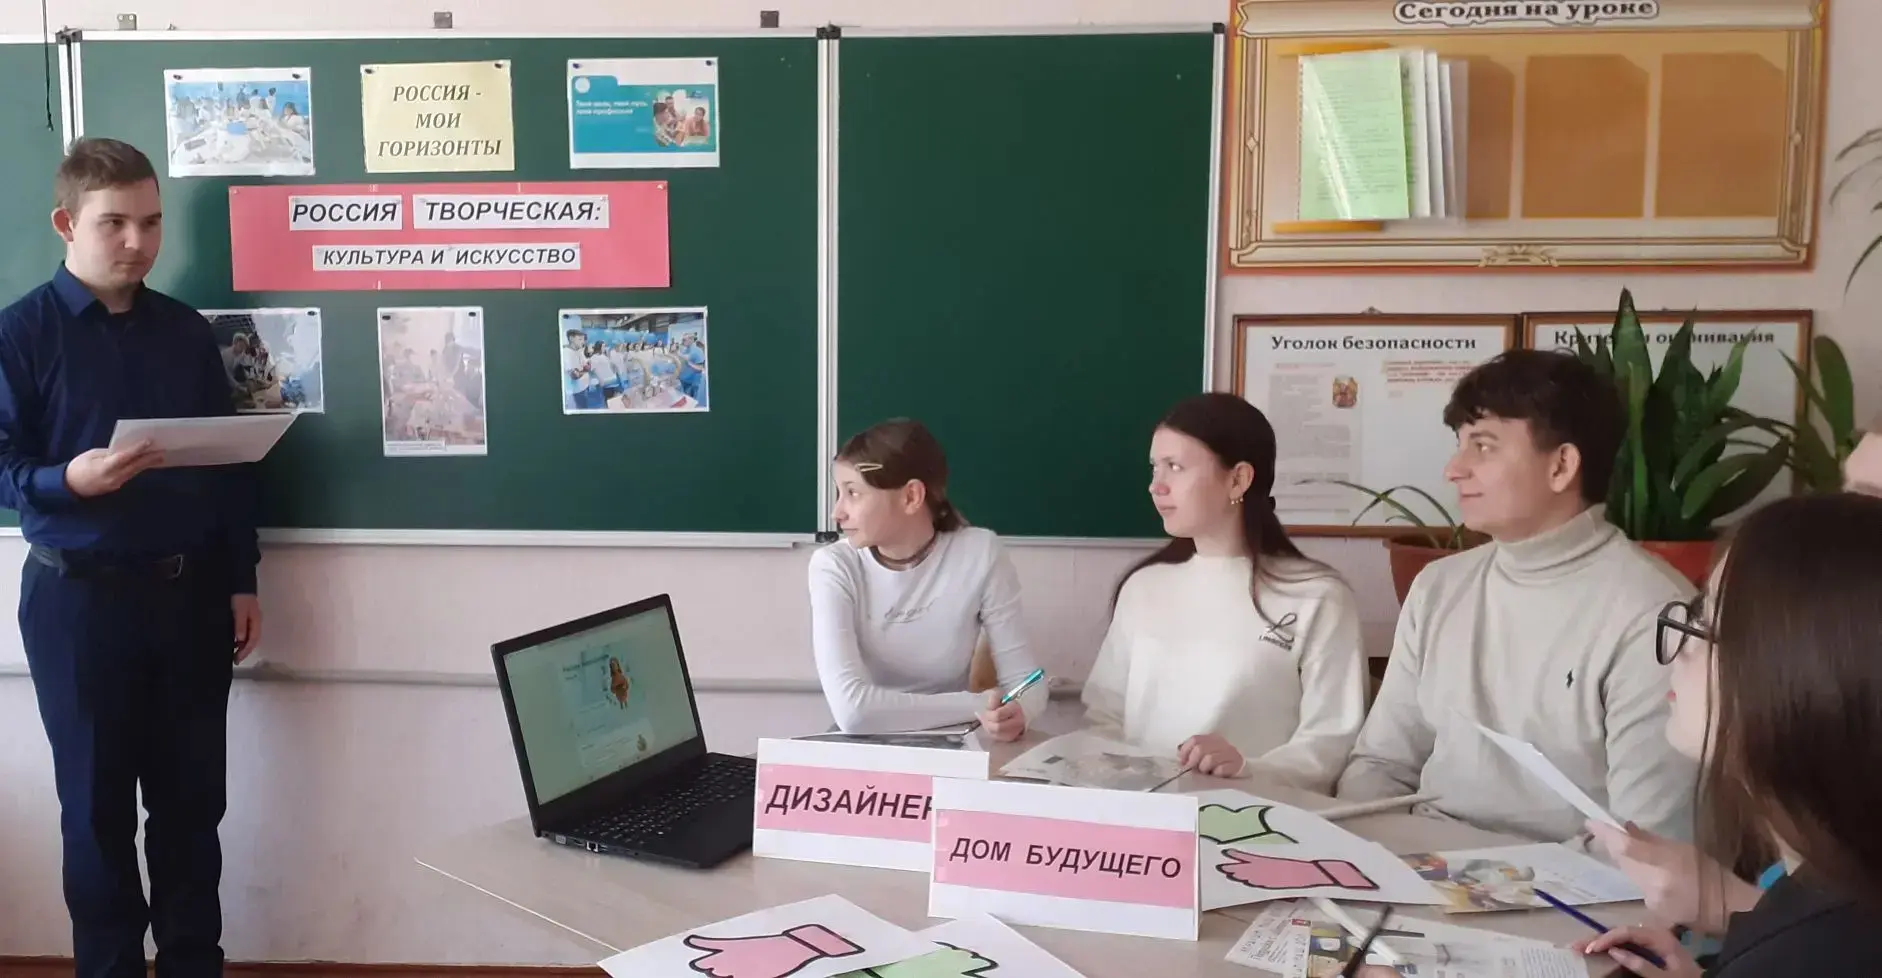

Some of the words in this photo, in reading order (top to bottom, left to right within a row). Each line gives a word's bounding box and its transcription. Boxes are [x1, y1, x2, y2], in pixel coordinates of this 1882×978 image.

[1400, 3, 1517, 19] Сегодня
[1526, 4, 1559, 15] на
[1566, 3, 1654, 20] уроке
[393, 84, 471, 102] РОССИЯ
[415, 112, 462, 129] МОИ
[378, 139, 503, 157] ГОРИЗОНТЫ
[292, 202, 398, 223] РОССИЯ
[426, 201, 602, 222] ТВОРЧЕСКАЯ:
[323, 249, 425, 266] КУЛЬТУРА
[430, 249, 445, 265] И
[455, 248, 577, 266] ИСКУССТВО
[1271, 336, 1339, 350] Уголок
[1342, 335, 1477, 350] безопасности
[950, 837, 1012, 863] ДОМ
[1026, 844, 1182, 880] БУДУЩЕГО
